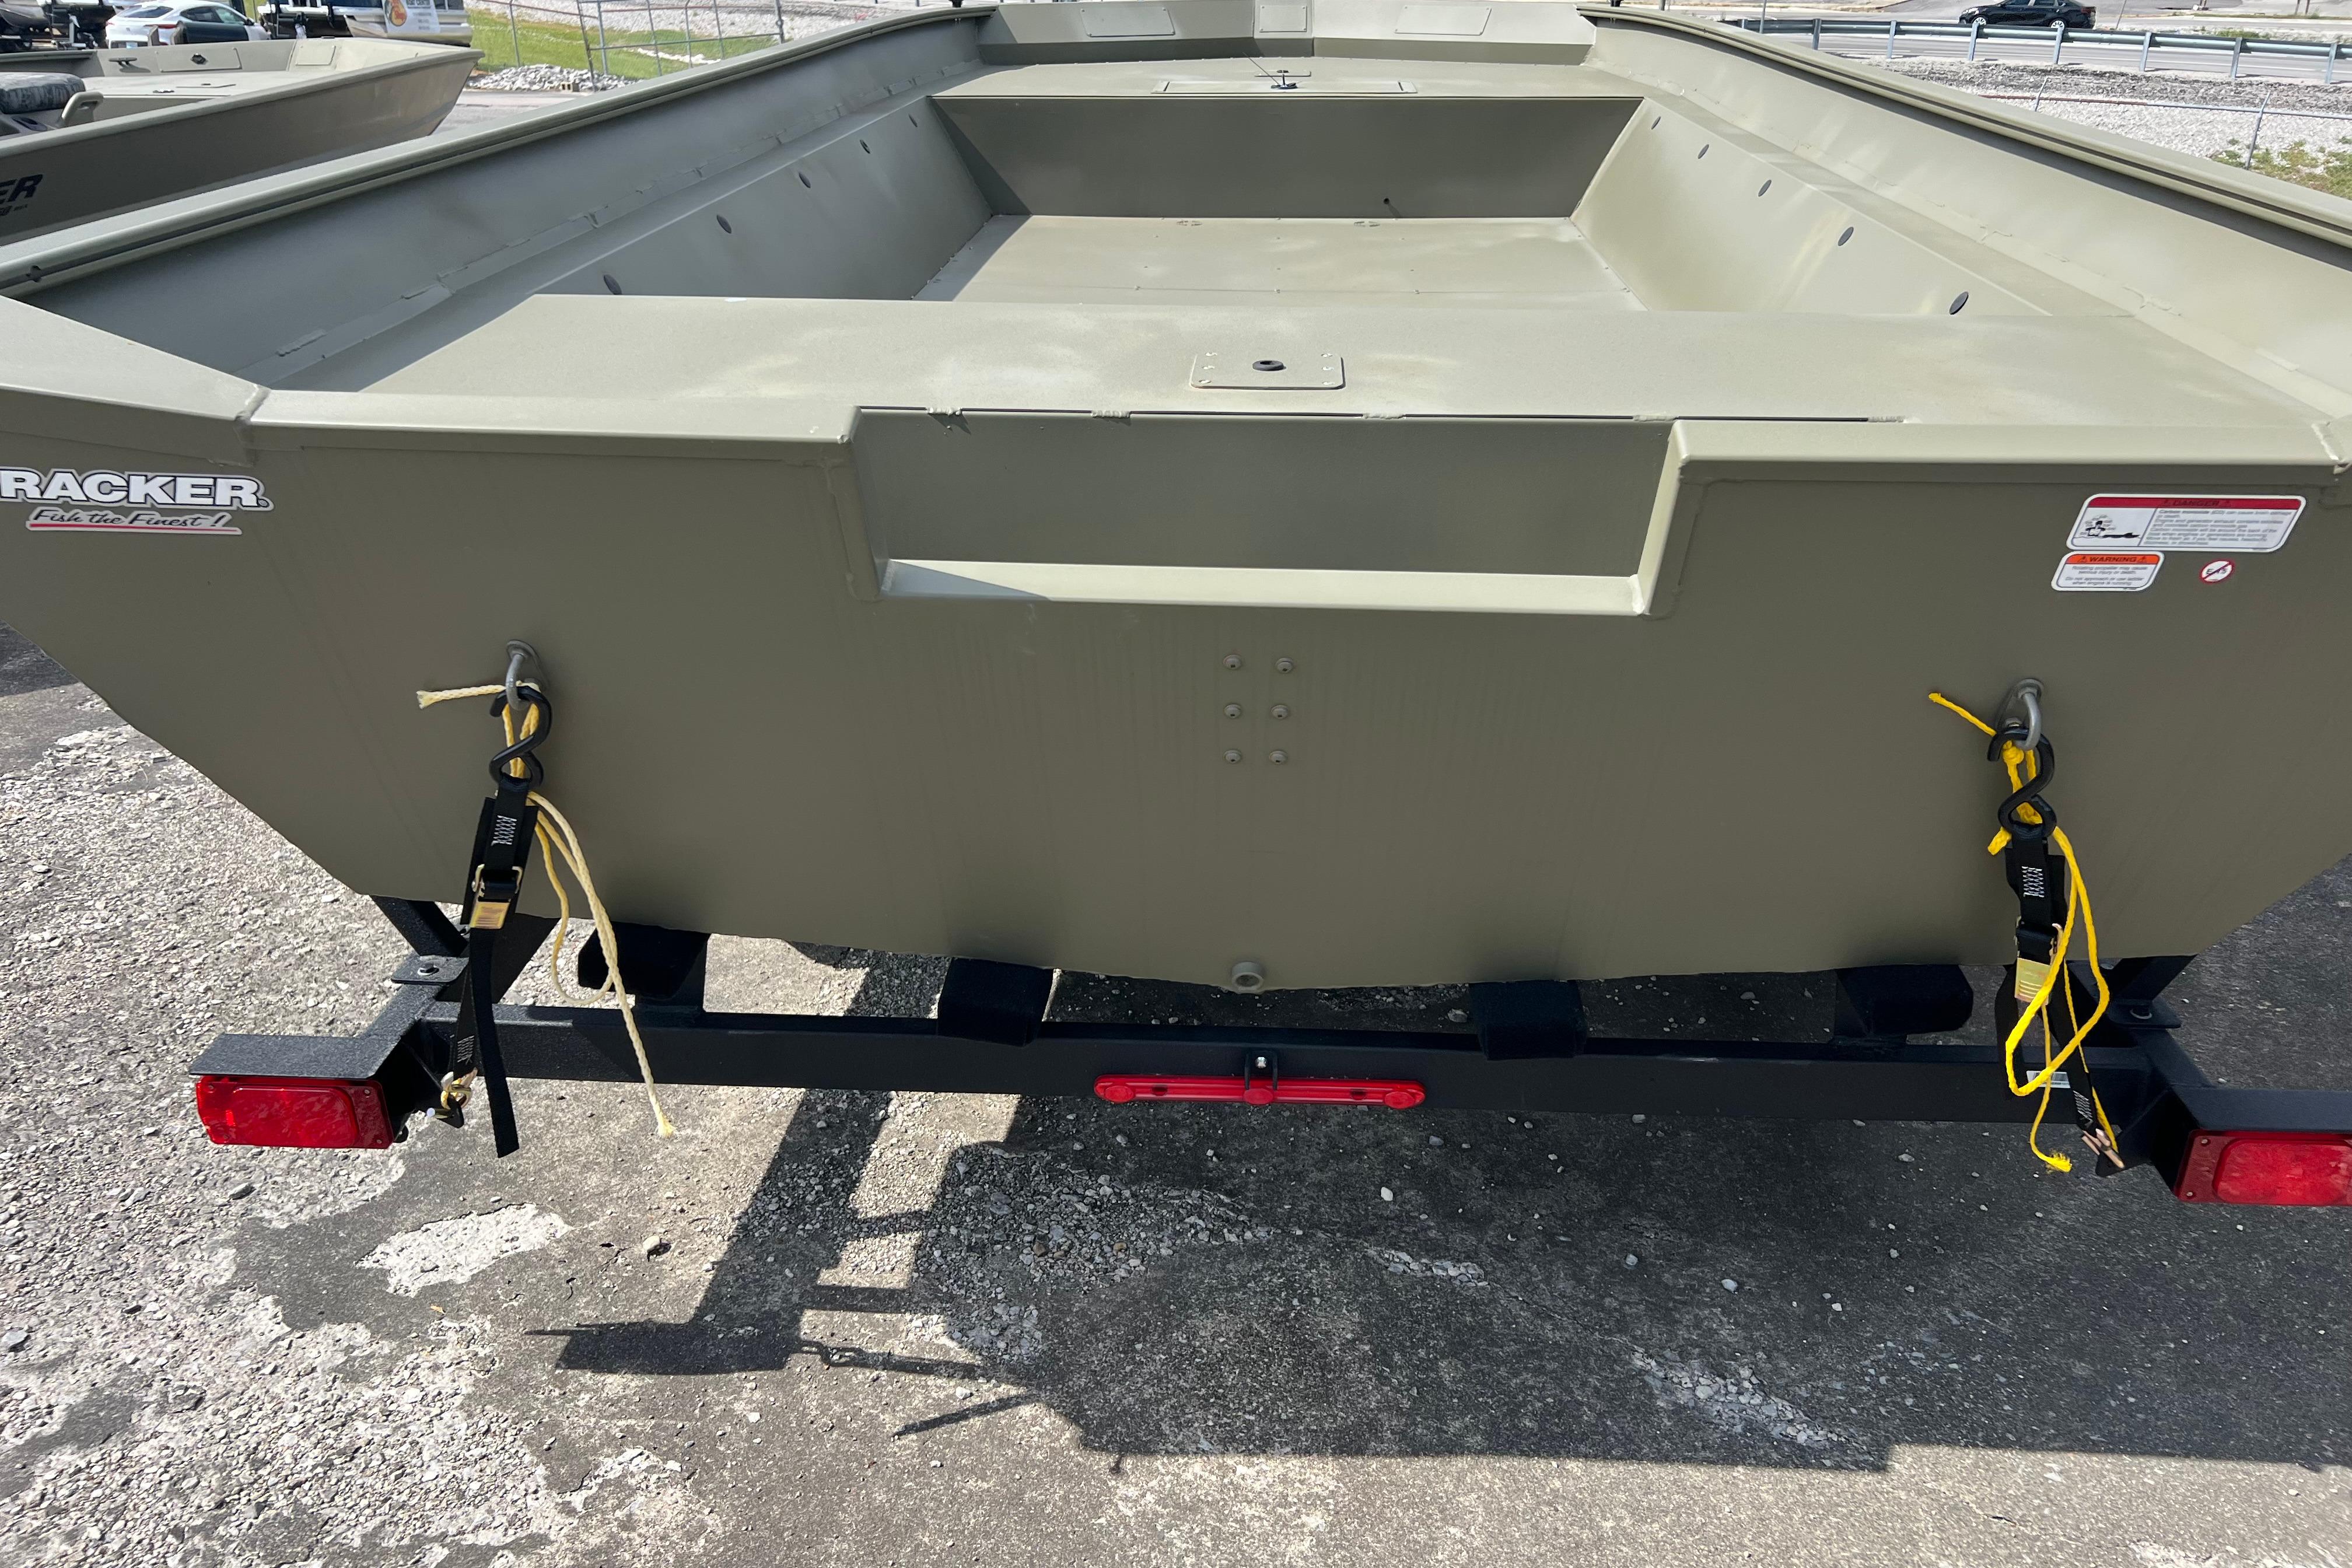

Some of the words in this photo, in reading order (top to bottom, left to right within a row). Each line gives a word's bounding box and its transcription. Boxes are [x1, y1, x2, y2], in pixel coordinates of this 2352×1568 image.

[0, 469, 262, 508] RACKER
[33, 509, 83, 523] Fish
[87, 513, 126, 524] the
